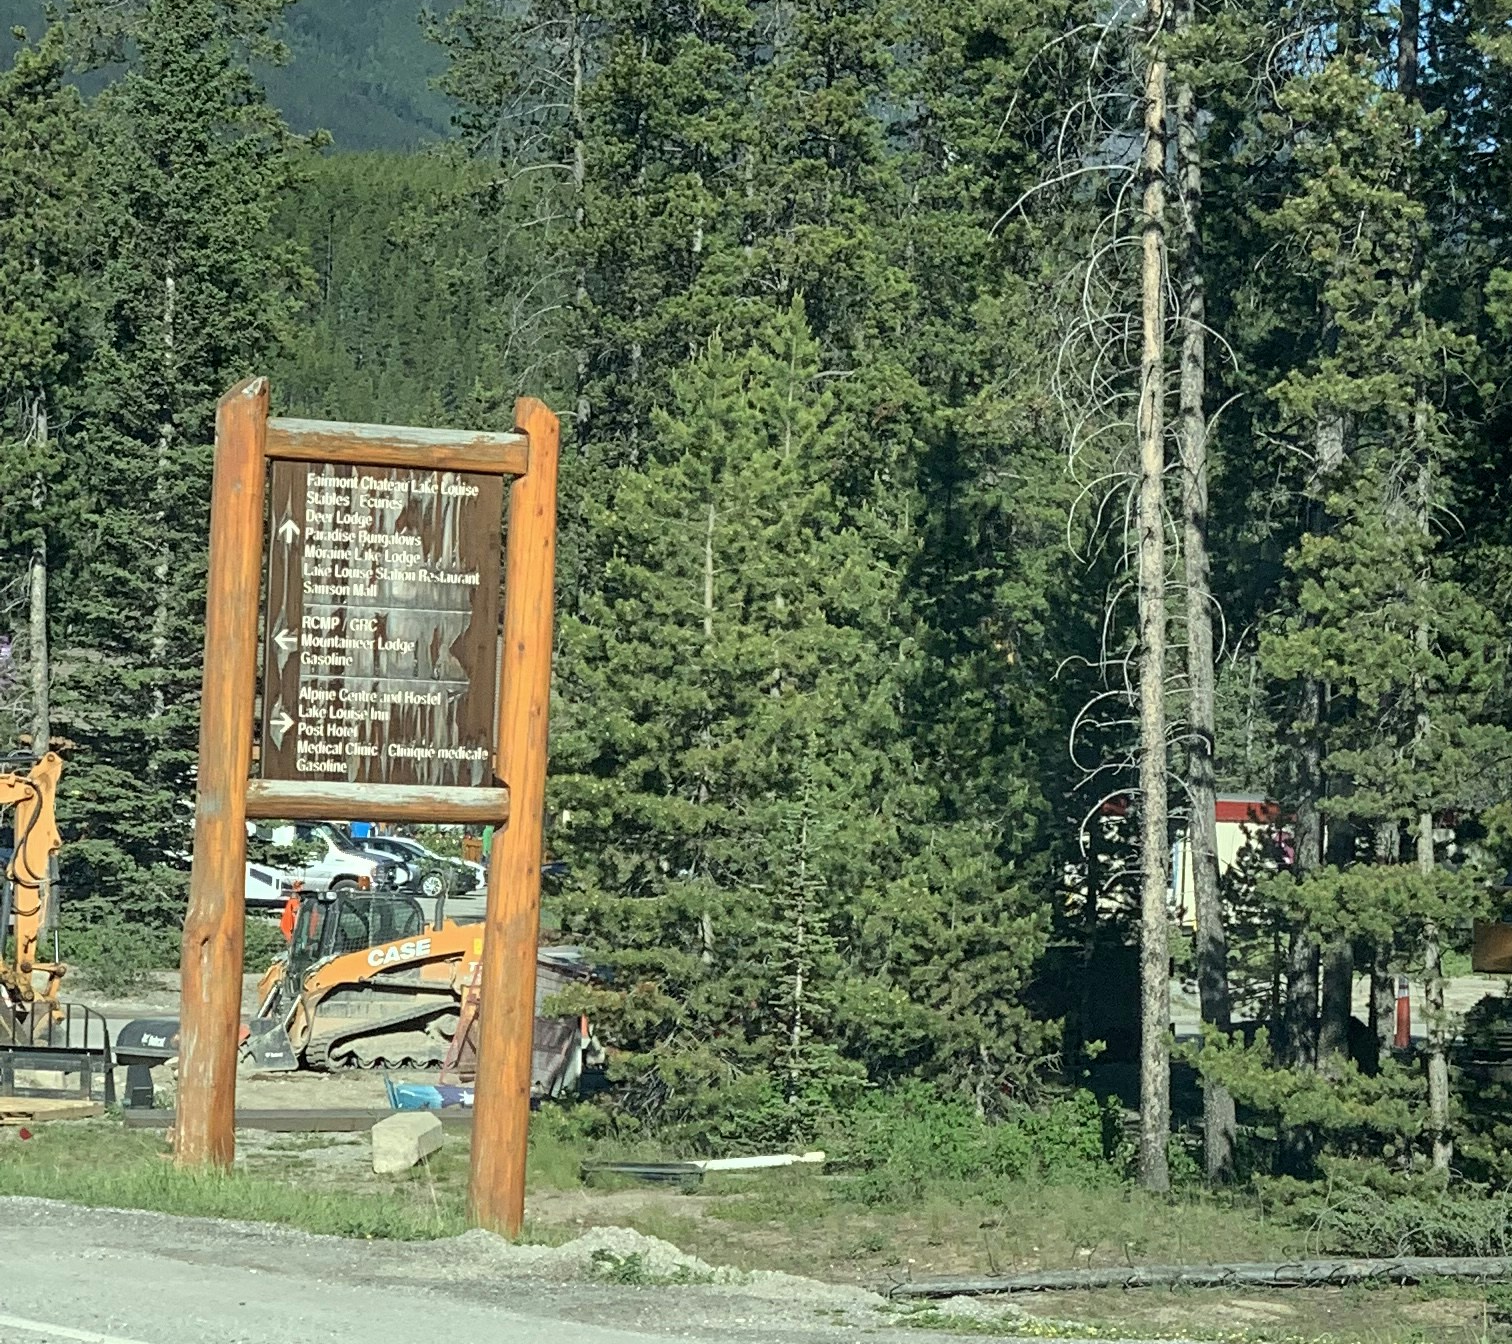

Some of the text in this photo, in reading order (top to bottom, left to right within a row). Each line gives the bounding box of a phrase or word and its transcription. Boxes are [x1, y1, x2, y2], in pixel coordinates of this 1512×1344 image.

[307, 473, 479, 496] Fairmont Chateau Lake Louise
[307, 491, 350, 506] Stables
[306, 509, 372, 527] Deer Lodge
[305, 528, 421, 546] Paradise Bungalows
[305, 545, 420, 566] Moraine Lake Lodge
[304, 563, 479, 585] Lake Louise Station Restaurant
[304, 581, 376, 596] Samson Mall
[302, 616, 340, 630] RCMP
[350, 618, 377, 631] GRC
[301, 635, 415, 654] Mountaineer Lodge
[301, 653, 353, 666] Gasoline
[299, 687, 336, 703] Alpine
[339, 689, 376, 703] Centre
[405, 691, 441, 705] Hostel
[299, 705, 389, 721] Lake Louise Inn
[298, 722, 358, 737] Post Hotel
[297, 740, 341, 754] Medical
[345, 742, 378, 756] Clinic
[296, 758, 347, 772] Gasoline
[367, 938, 431, 966] CASE
